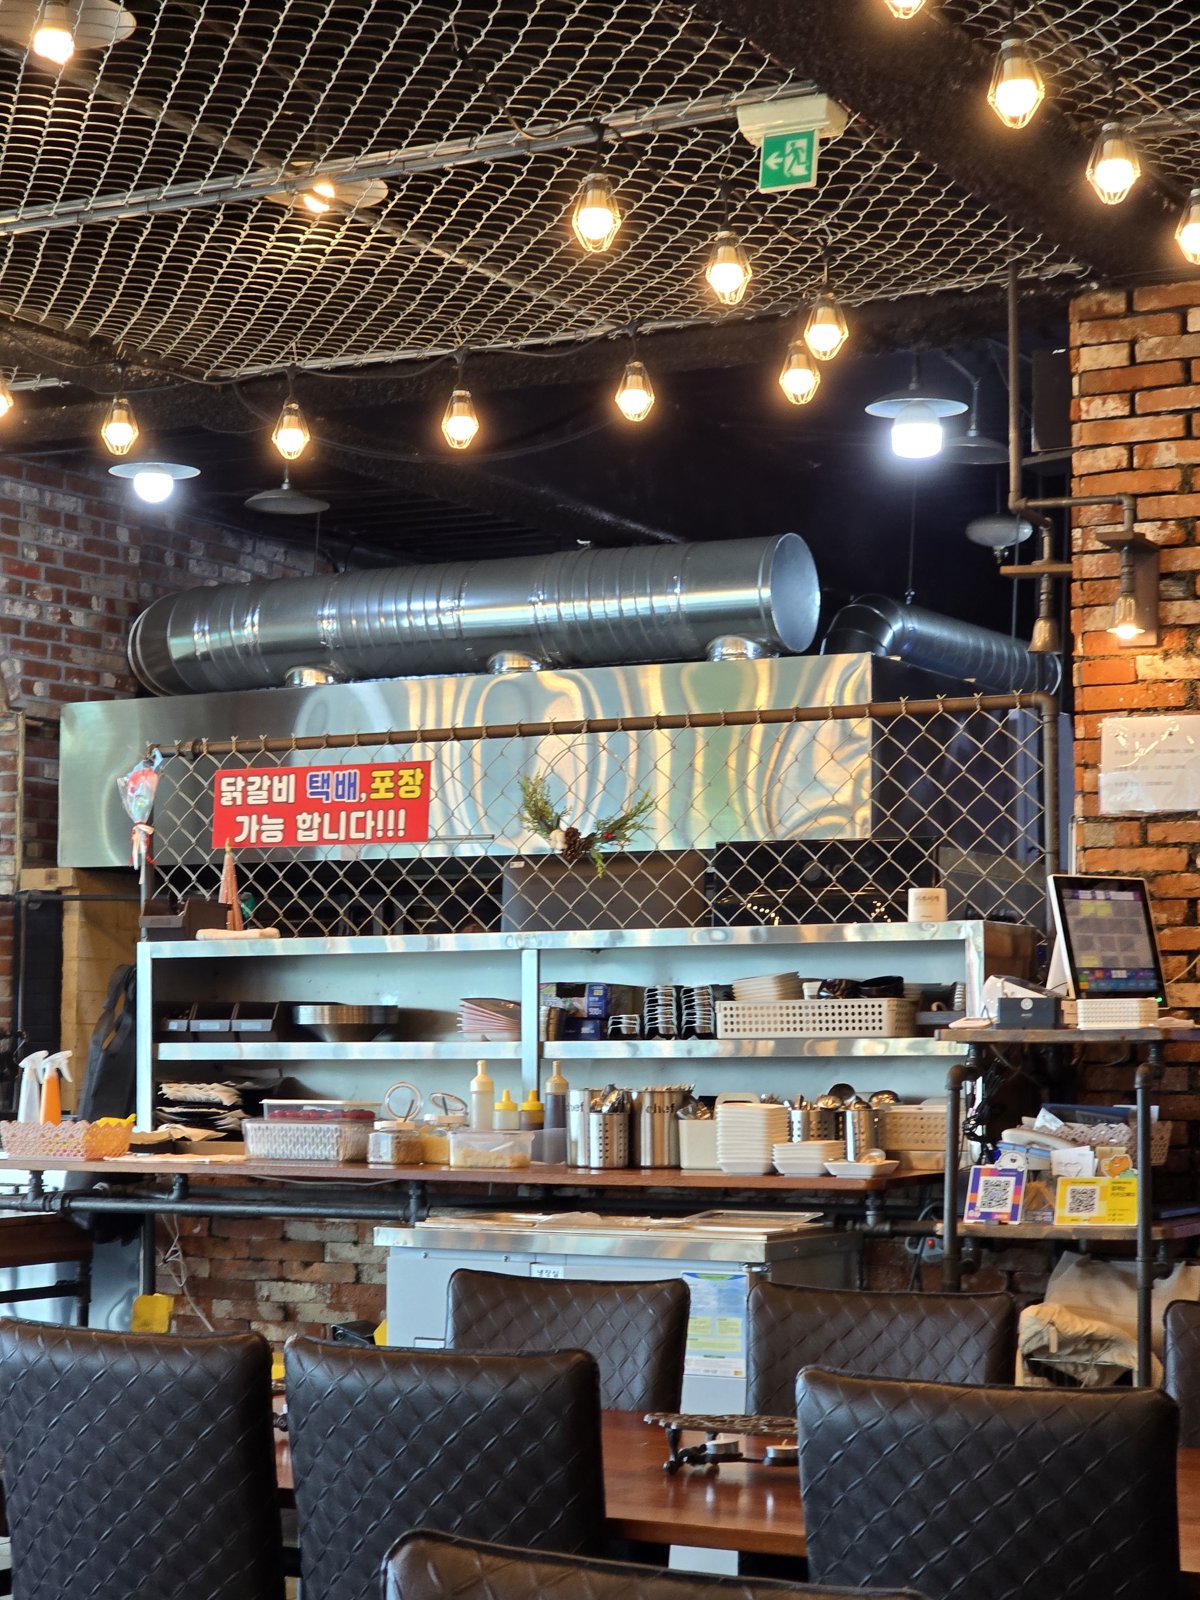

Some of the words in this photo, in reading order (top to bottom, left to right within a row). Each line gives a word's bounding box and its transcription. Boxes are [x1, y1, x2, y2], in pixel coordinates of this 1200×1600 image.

[219, 773, 296, 807] 닭갈비
[233, 813, 285, 844] 가능
[295, 808, 407, 843] 합니다!!!
[645, 1102, 676, 1114] chef
